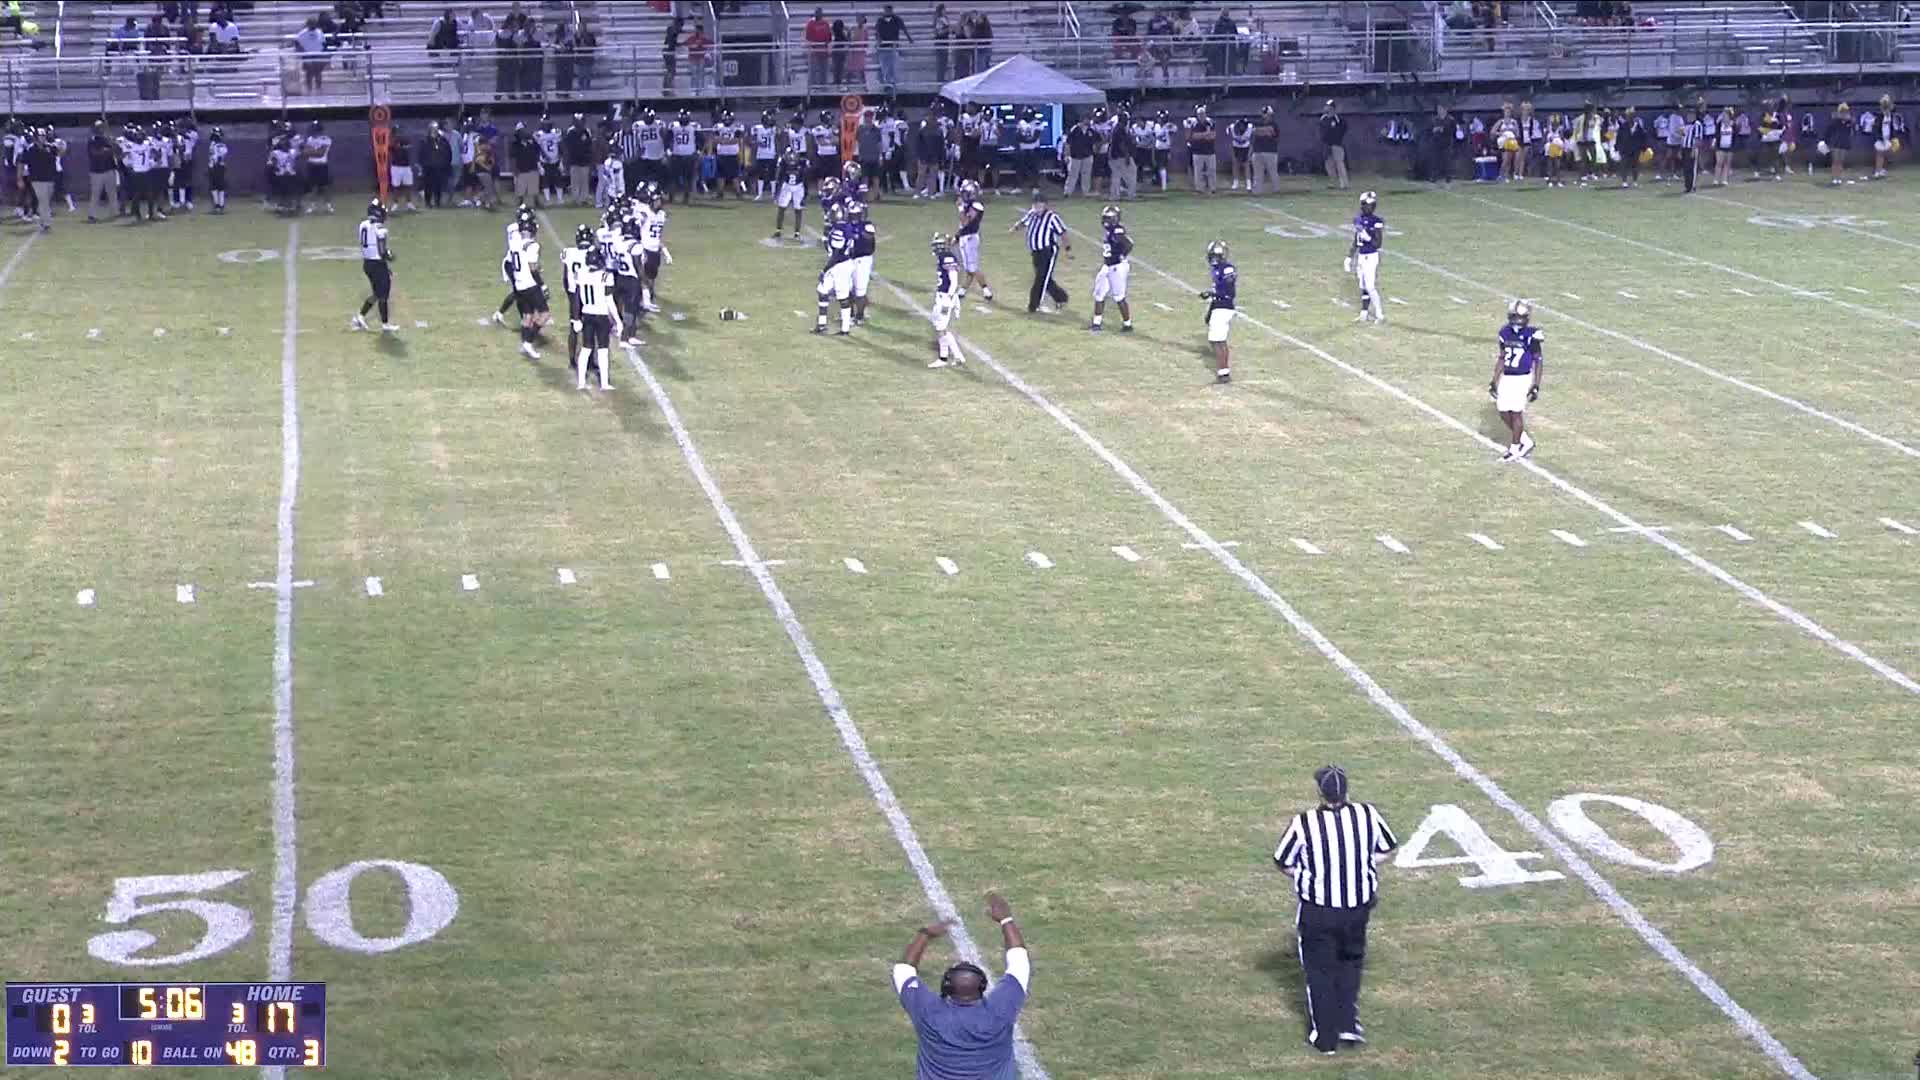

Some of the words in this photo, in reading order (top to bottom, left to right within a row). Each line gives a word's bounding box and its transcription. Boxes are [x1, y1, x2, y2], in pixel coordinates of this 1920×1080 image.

[584, 284, 596, 305] 11
[1504, 347, 1526, 368] 27
[1393, 793, 1714, 889] 40
[87, 858, 460, 967] 50
